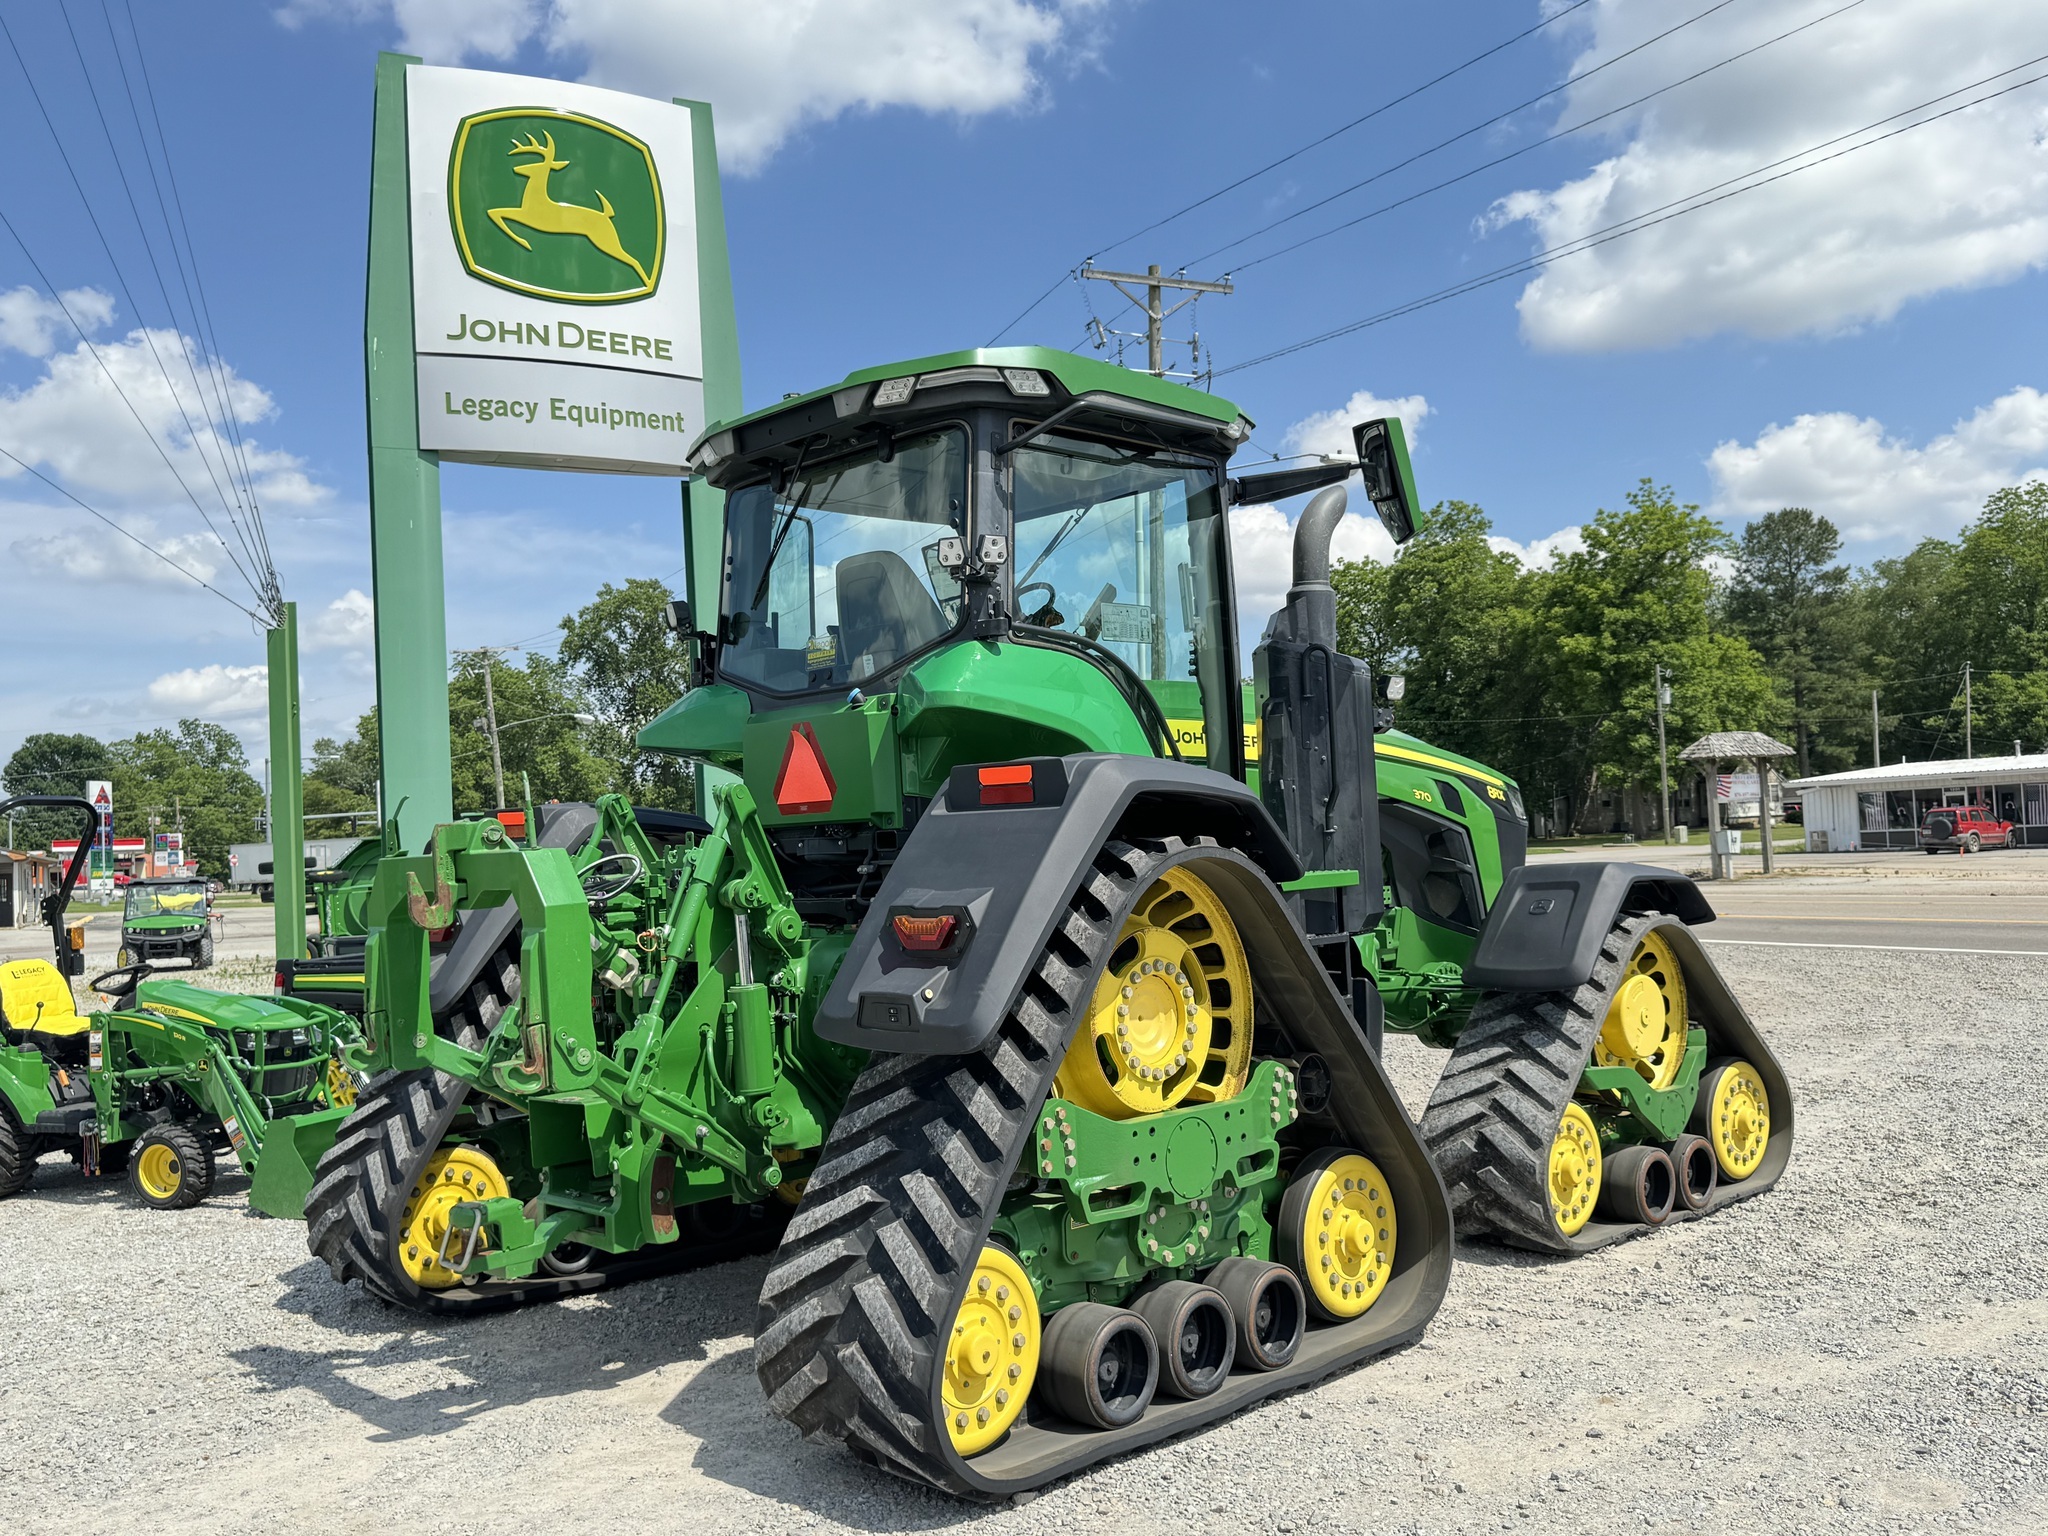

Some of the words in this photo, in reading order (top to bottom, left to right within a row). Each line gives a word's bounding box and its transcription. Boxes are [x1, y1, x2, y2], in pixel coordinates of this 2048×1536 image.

[446, 313, 550, 347] JOHN
[558, 321, 673, 361] DEERE
[444, 391, 539, 423] Legacy
[549, 397, 685, 434] Equipment
[1174, 728, 1204, 745] JOH
[1412, 789, 1432, 803] 370
[19, 966, 45, 975] LEGACY
[160, 1005, 180, 1016] DEERE
